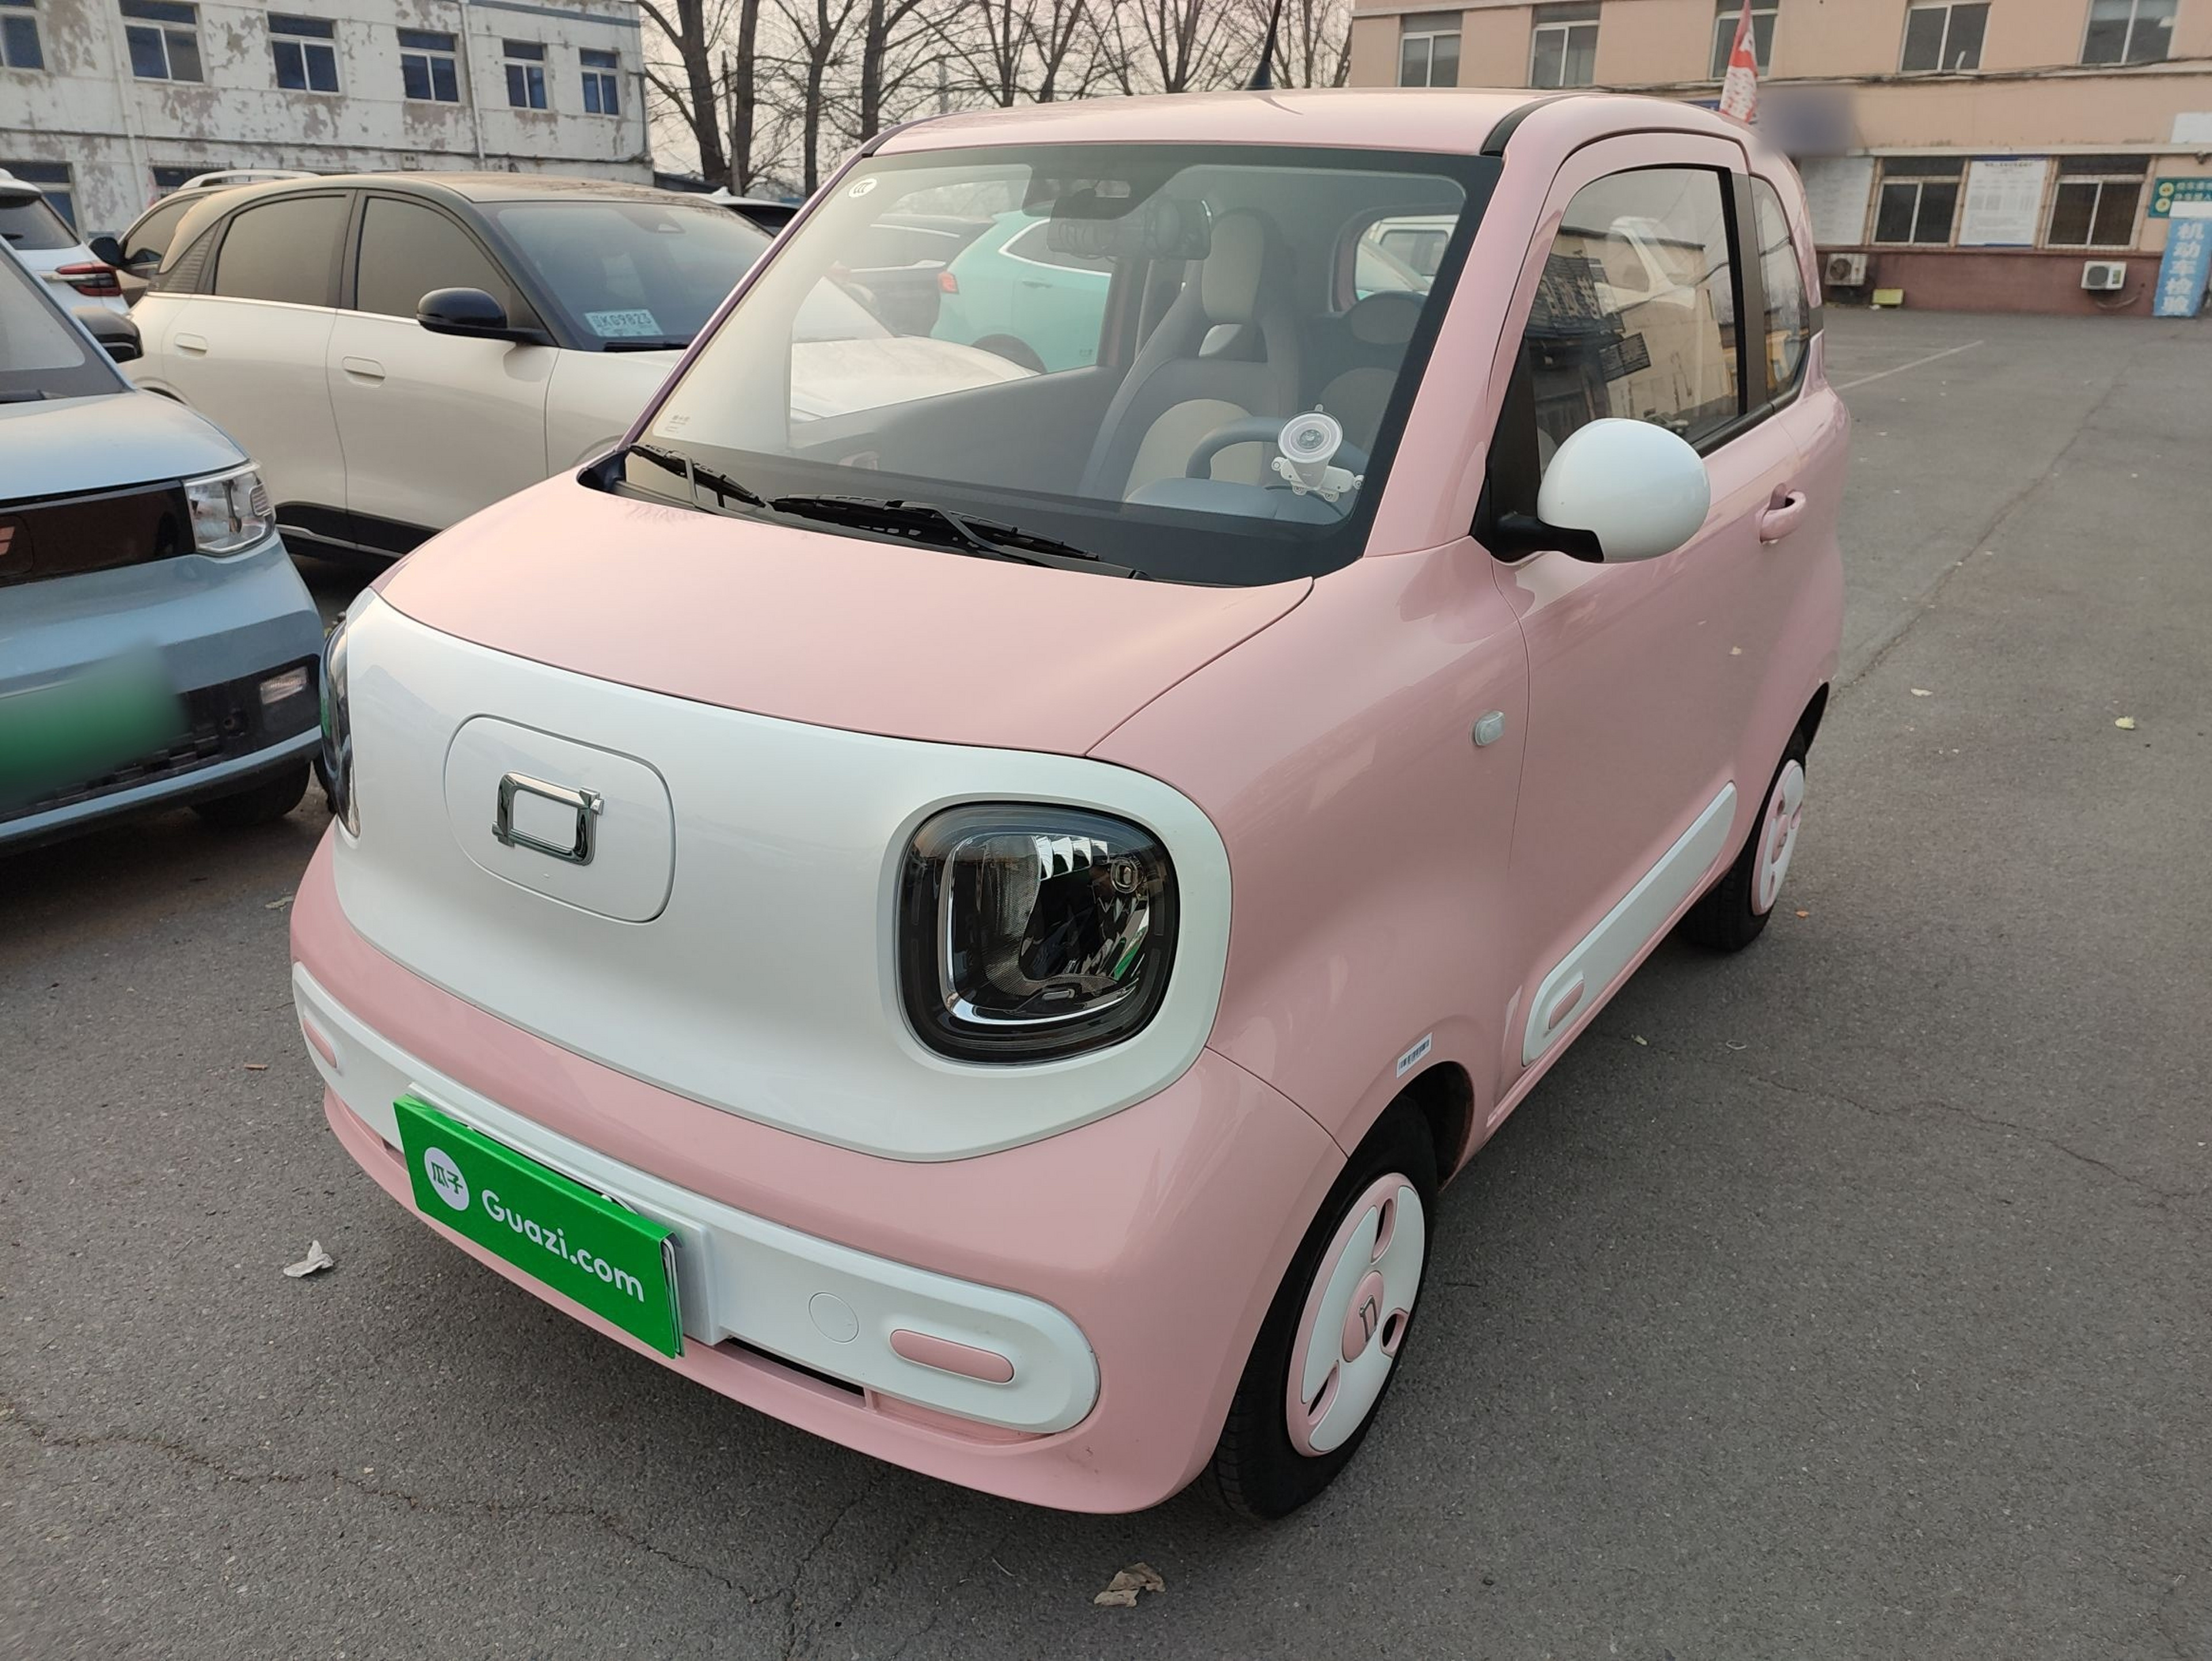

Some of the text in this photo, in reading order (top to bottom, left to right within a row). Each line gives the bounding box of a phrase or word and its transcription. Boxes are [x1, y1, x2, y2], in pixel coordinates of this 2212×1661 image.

[2161, 222, 2205, 313] 机动车检验
[430, 1161, 464, 1195] 瓜子
[482, 1189, 645, 1303] Guazi.com
